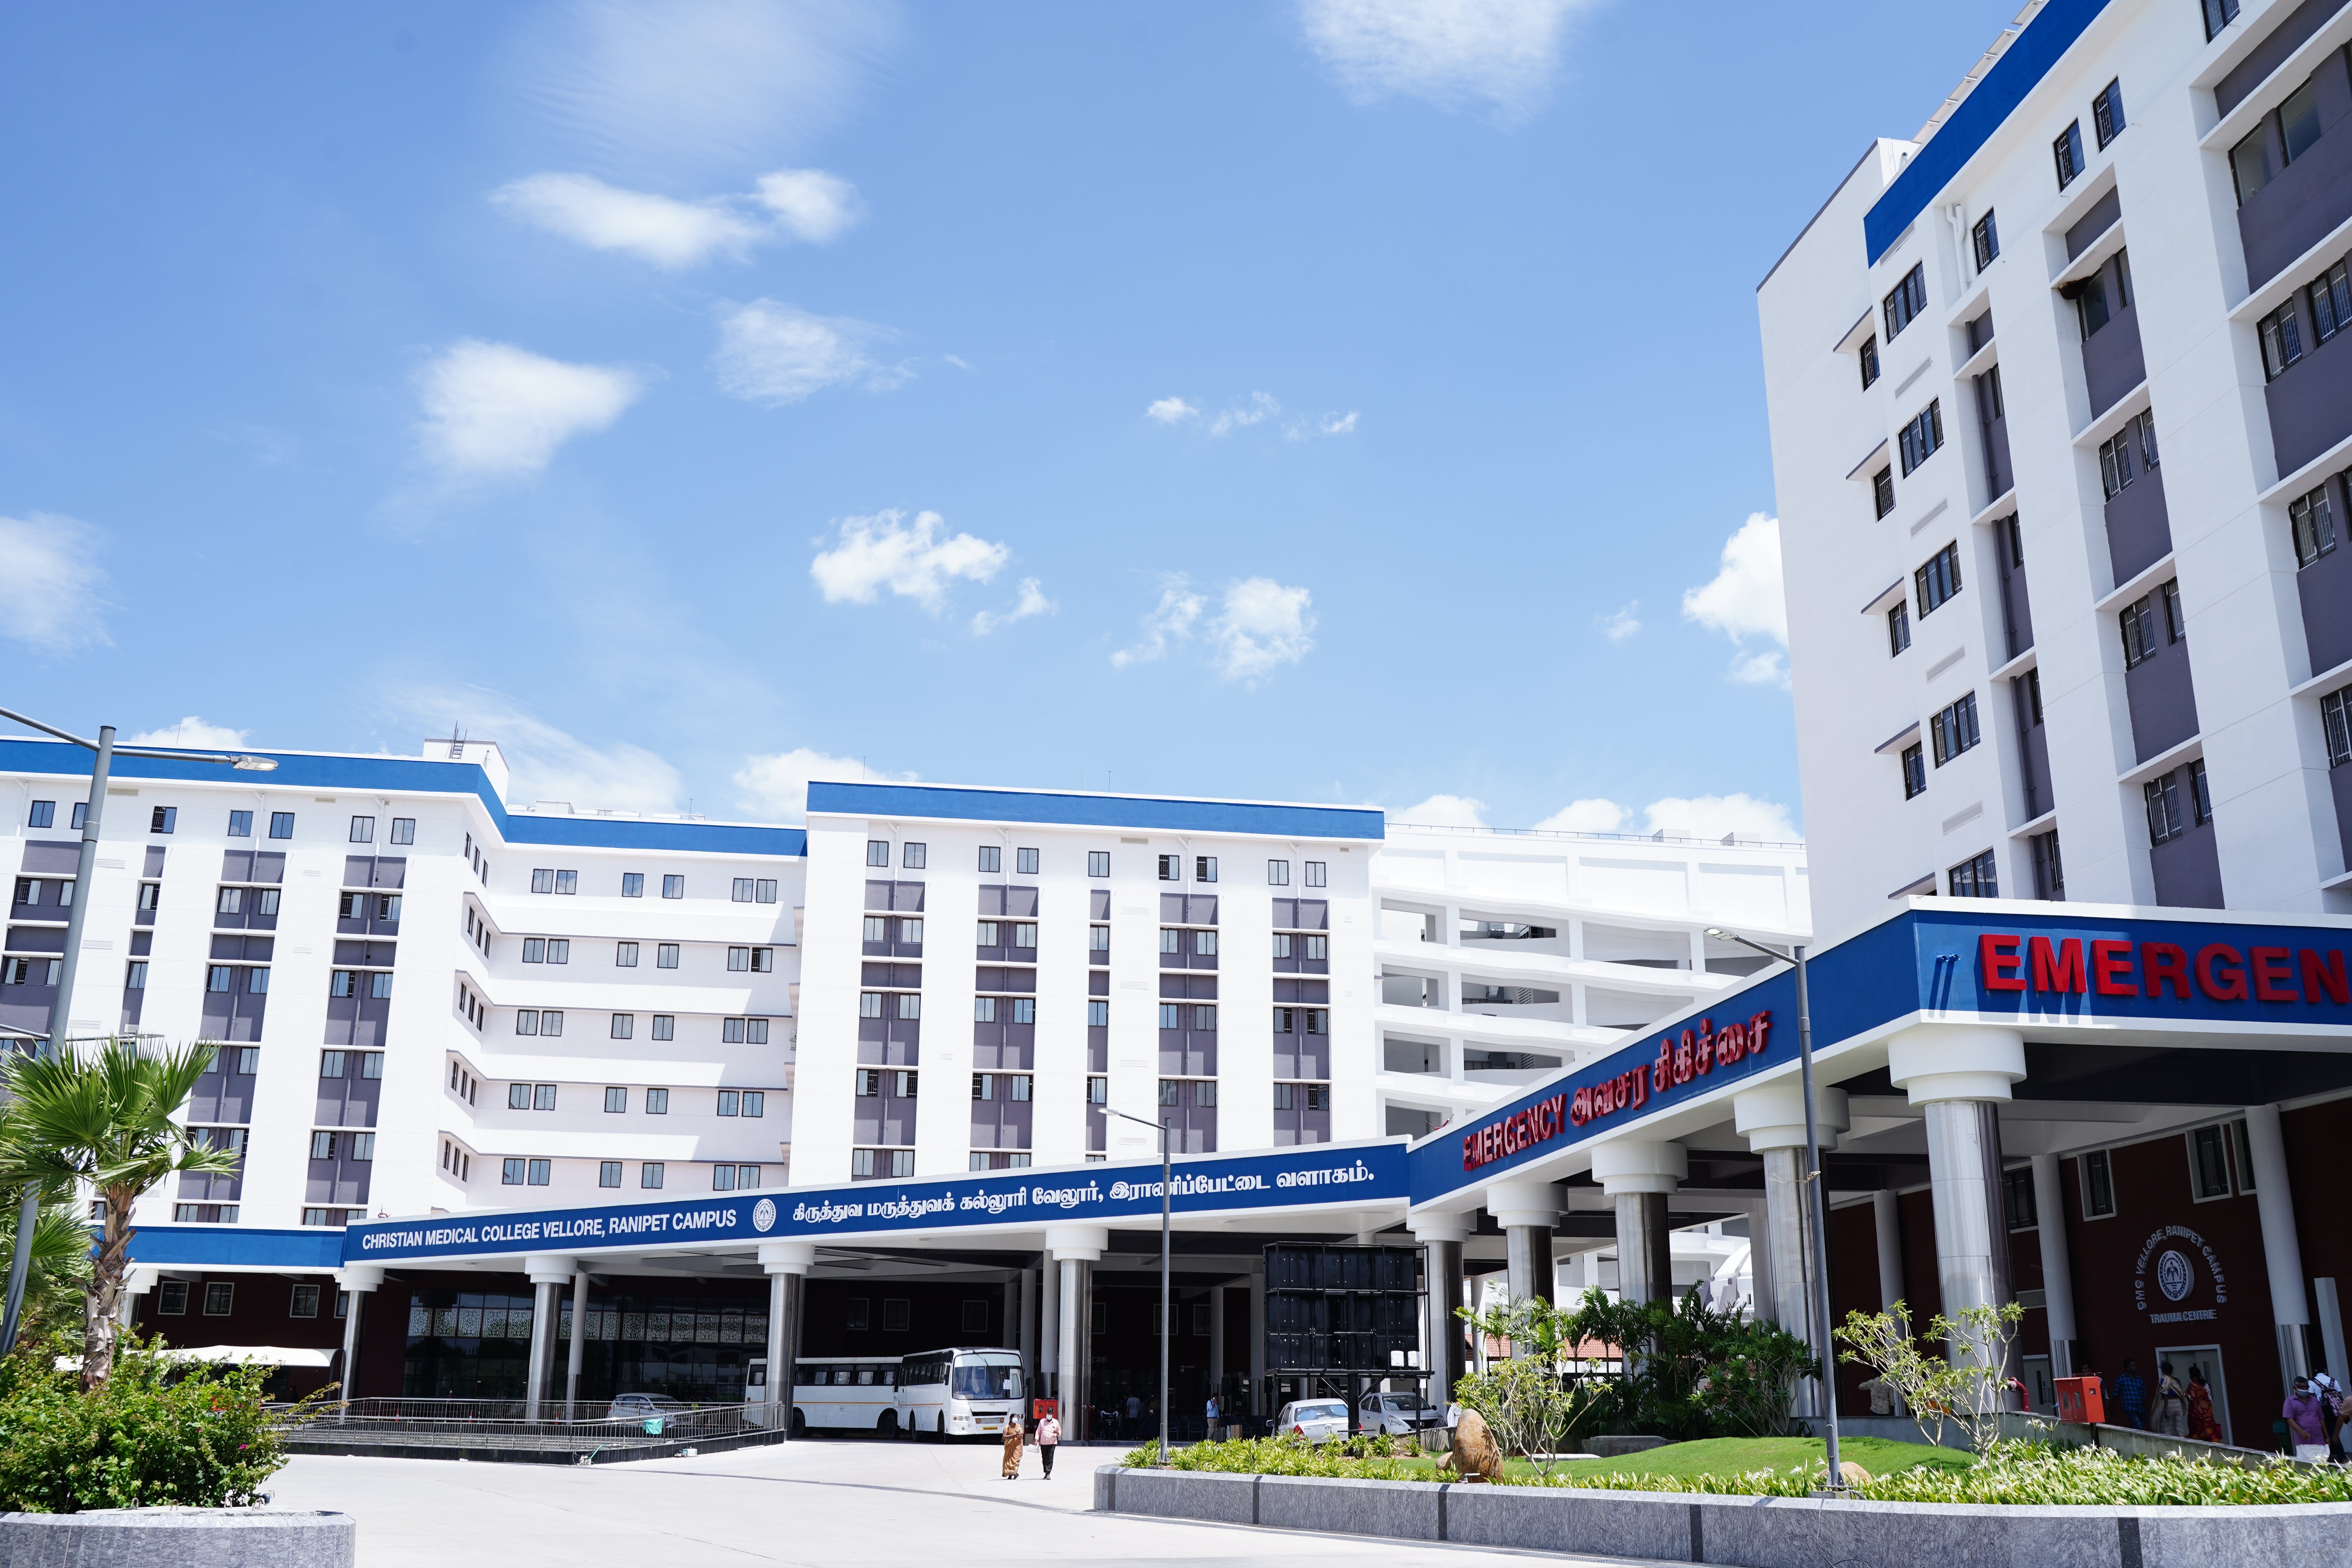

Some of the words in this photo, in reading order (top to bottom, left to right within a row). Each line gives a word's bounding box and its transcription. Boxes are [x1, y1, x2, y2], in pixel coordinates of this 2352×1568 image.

[1570, 1065, 1650, 1126] அவசர
[1653, 1011, 1773, 1092] சிகிச்சை
[1463, 1094, 1566, 1171] EMERGENCY
[793, 1200, 863, 1223] கிருத்துவ
[867, 1192, 955, 1219] மருத்துவக்
[960, 1186, 1027, 1214] கல்லூரி
[1032, 1180, 1103, 1209] வேலூர்,
[1276, 1160, 1374, 1188] வளாகம்.
[363, 1231, 423, 1250] CHRISTIAN
[425, 1227, 478, 1245] MEDICAL
[481, 1223, 540, 1242] COLLEGE
[543, 1219, 605, 1238] VELLORE,
[609, 1214, 670, 1234] RANIPET
[672, 1209, 736, 1230] CAMPUS
[2135, 1229, 2167, 1275] VELLORE,
[2165, 1225, 2205, 1248] RANIPET
[2135, 1279, 2147, 1311] CMC
[2202, 1245, 2227, 1304] CAMPUS
[2149, 1311, 2183, 1324] TRAUMA
[2182, 1309, 2217, 1321] CENTRE
